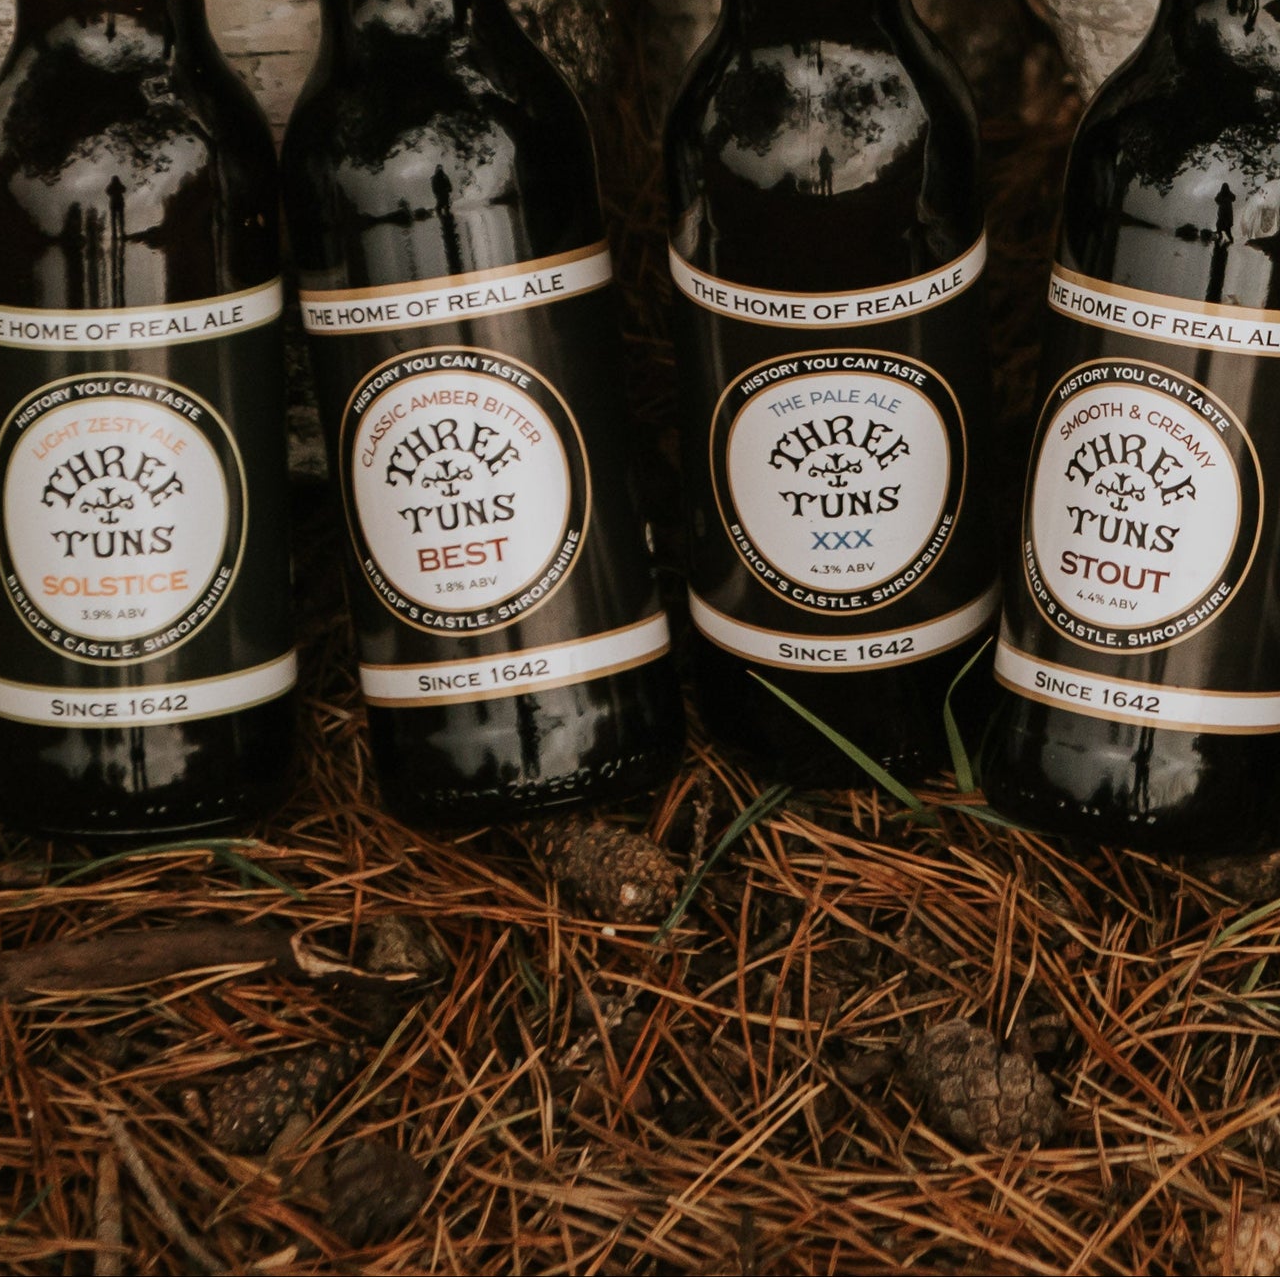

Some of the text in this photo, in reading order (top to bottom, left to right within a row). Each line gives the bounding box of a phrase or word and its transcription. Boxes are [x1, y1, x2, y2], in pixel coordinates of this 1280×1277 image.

[308, 273, 564, 326] THE HOME OF REAL ALE
[691, 268, 963, 320] THE HOME OF REAL ALE
[1051, 281, 1069, 306] THE
[1071, 292, 1127, 323] HOME
[1132, 310, 1166, 330] OF
[1172, 317, 1241, 344] REAL
[10, 322, 78, 340] HOME
[86, 323, 120, 340] OF
[129, 317, 197, 339] REAL
[203, 306, 243, 329] ALE
[353, 355, 531, 413] HISTORY YOU CAN TASTE
[740, 357, 926, 395] HISTORY YOU CAN TASTE
[15, 382, 203, 428] HISTORY YOU CAN TASTE
[768, 389, 902, 417] THE PALE ALE
[1059, 367, 1231, 433] HISTORY YOU CAN TASTE
[31, 417, 188, 461] LIGHT ZESTY ALE
[362, 390, 542, 468] CLASSIC AMBER BITTER
[767, 415, 910, 472] THREE
[1060, 402, 1216, 469] SMOOTH & CREAMY
[385, 418, 521, 487] THREE
[1064, 432, 1196, 506] THREE
[41, 445, 184, 509] THREE
[397, 492, 516, 535] TUNS
[779, 484, 901, 518] TUNS
[51, 525, 175, 558] TUNS
[811, 529, 873, 550] XXX
[1066, 505, 1180, 553] TUNS
[364, 558, 419, 619] BISHOP'S
[498, 529, 580, 618] SHROPSHIRE
[417, 537, 509, 572] BEST
[730, 524, 789, 592] BISHOP'S
[871, 514, 953, 602] SHROPSHIRE
[810, 561, 876, 574] 4.3% ABV
[1060, 550, 1170, 594] STOUT
[42, 571, 188, 597] SOLSTICE
[435, 576, 497, 594] 3.8% ABV
[1025, 540, 1056, 615] BISHOP'S
[1128, 582, 1231, 646] SHROPSHIRE
[1076, 590, 1138, 611] 4.4% ABV
[7, 574, 61, 642] BISHOP'S
[143, 566, 232, 652] SHROPSHIRE
[81, 608, 146, 620] 3.9% ABV
[857, 637, 914, 660] 1642
[491, 659, 550, 683] 1642
[129, 695, 188, 714] 1642
[1102, 688, 1160, 714] 1642
